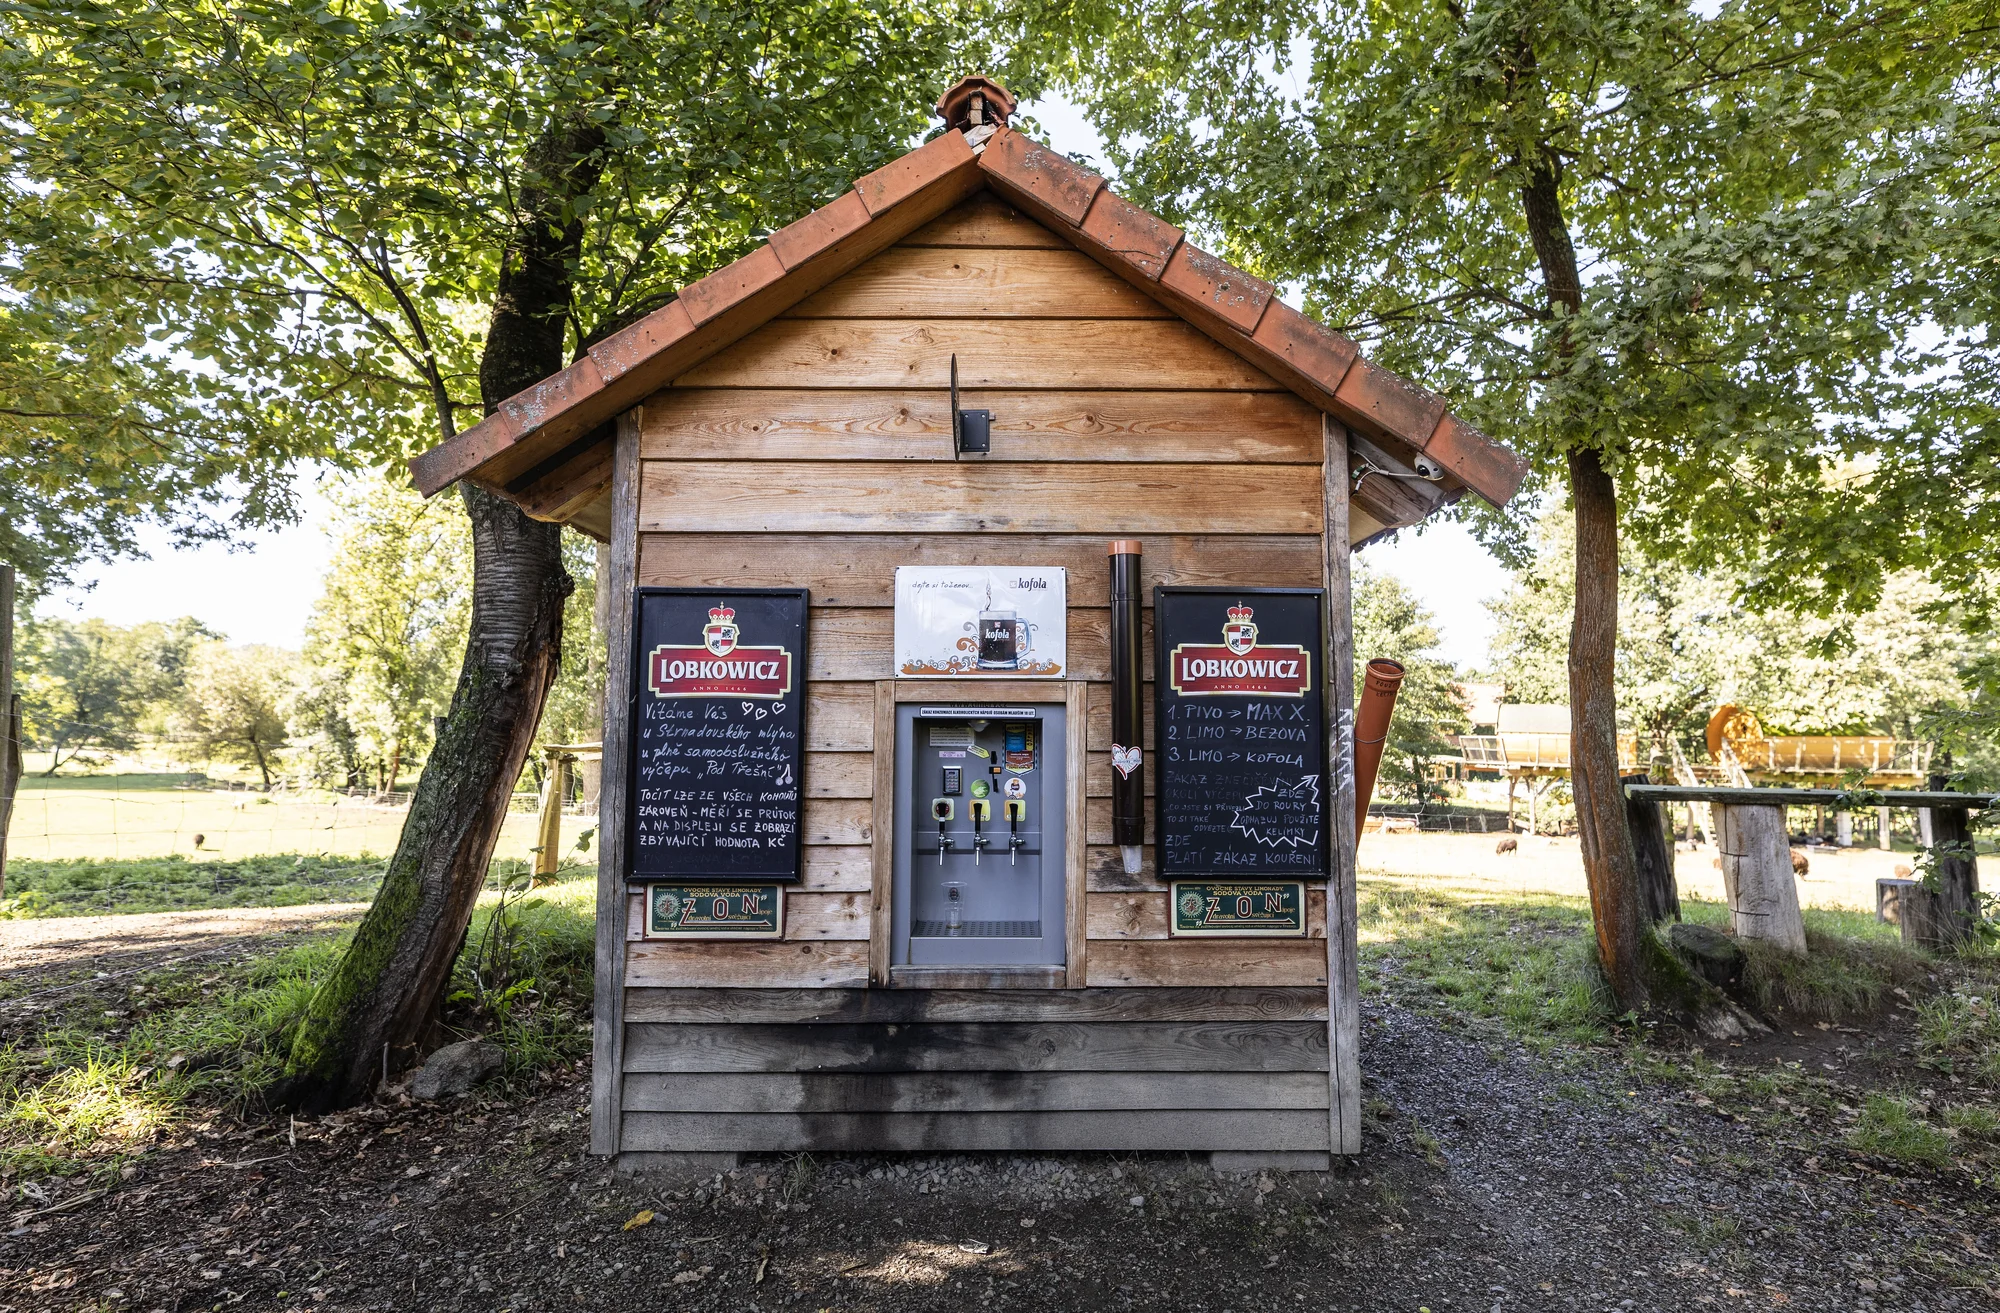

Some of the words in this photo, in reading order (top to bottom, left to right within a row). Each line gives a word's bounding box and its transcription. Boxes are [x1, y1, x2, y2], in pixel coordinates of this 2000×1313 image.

[1018, 578, 1047, 592] kofola
[985, 628, 1010, 642] kofola
[660, 658, 780, 683] LOBKOWICZ
[1182, 658, 1299, 681] LOBKOWICZ
[646, 701, 694, 720] Vítáme
[704, 702, 728, 720] Vás
[1168, 704, 1180, 720] 1.
[1184, 704, 1223, 719] PIVO
[1246, 703, 1284, 721] MAX
[643, 727, 652, 739] u
[656, 723, 752, 740] Strnadovského
[758, 723, 796, 746] mlýna
[1168, 726, 1181, 740] 2.
[1186, 726, 1224, 740] LIMO
[642, 749, 649, 758] u
[652, 742, 683, 762] plně
[1168, 746, 1185, 762] 3.
[1189, 748, 1223, 762] LIMO
[1246, 752, 1304, 768] KOFOLA
[640, 788, 672, 802] TOČIT
[674, 790, 696, 801] LZE
[699, 790, 716, 800] ZE
[723, 788, 753, 802] VŠECH
[1278, 788, 1306, 799] ZDE
[638, 804, 688, 818] ZÁROVEŇ
[700, 803, 735, 818] MĚŘÍ
[736, 808, 753, 818] SE
[758, 806, 796, 820] PRŮTOK
[1255, 801, 1270, 811] DO
[1274, 801, 1307, 812] ROURY
[638, 820, 648, 831] A
[654, 820, 670, 831] NA
[674, 819, 722, 832] DISPLEJI
[729, 822, 747, 833] SE
[1266, 827, 1306, 837] KELÍMKY
[640, 832, 708, 848] ZBÝVAJÍCÍ
[714, 836, 760, 848] HODNOTA
[768, 834, 787, 848] KČ
[1165, 834, 1192, 847] ZDE
[1166, 846, 1206, 864] PLATÍ
[1212, 844, 1258, 866] ZÁKAZ
[1265, 849, 1318, 866] KOUŘENÍ
